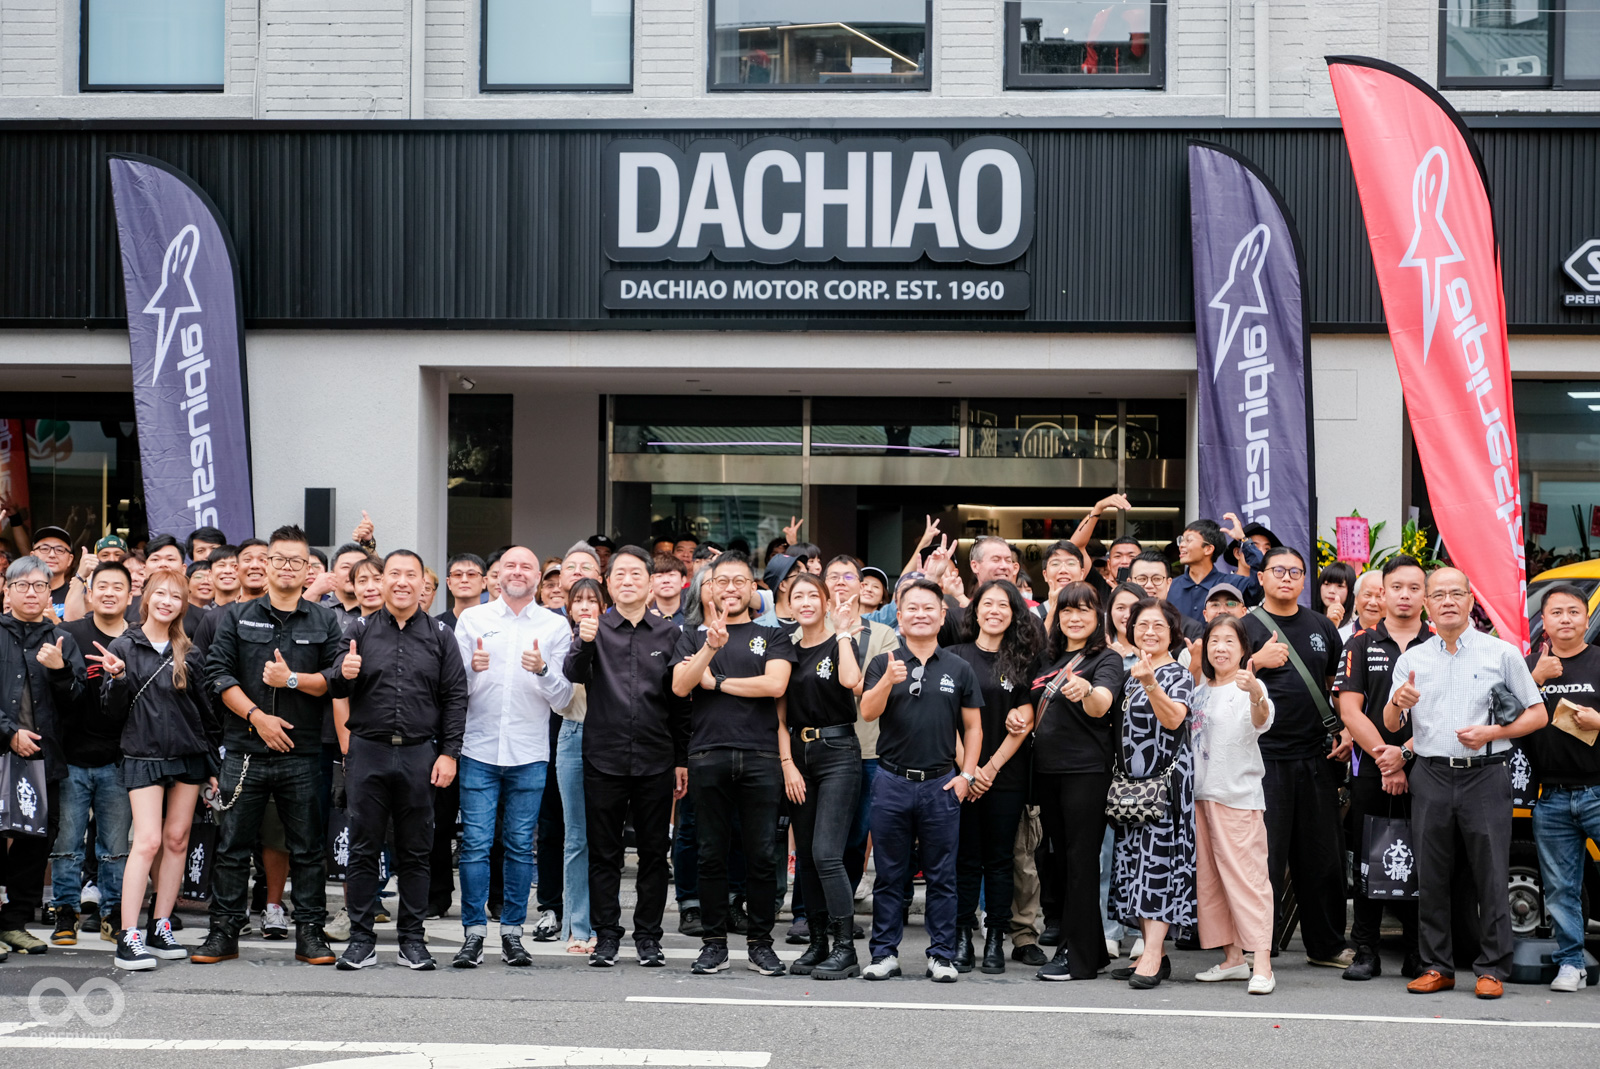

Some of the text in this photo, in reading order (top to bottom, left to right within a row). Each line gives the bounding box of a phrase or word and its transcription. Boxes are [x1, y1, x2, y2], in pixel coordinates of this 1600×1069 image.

[618, 148, 1022, 250] DACHIAO
[620, 279, 1005, 301] DACHIAO MOTOR CORP. EST. 1960
